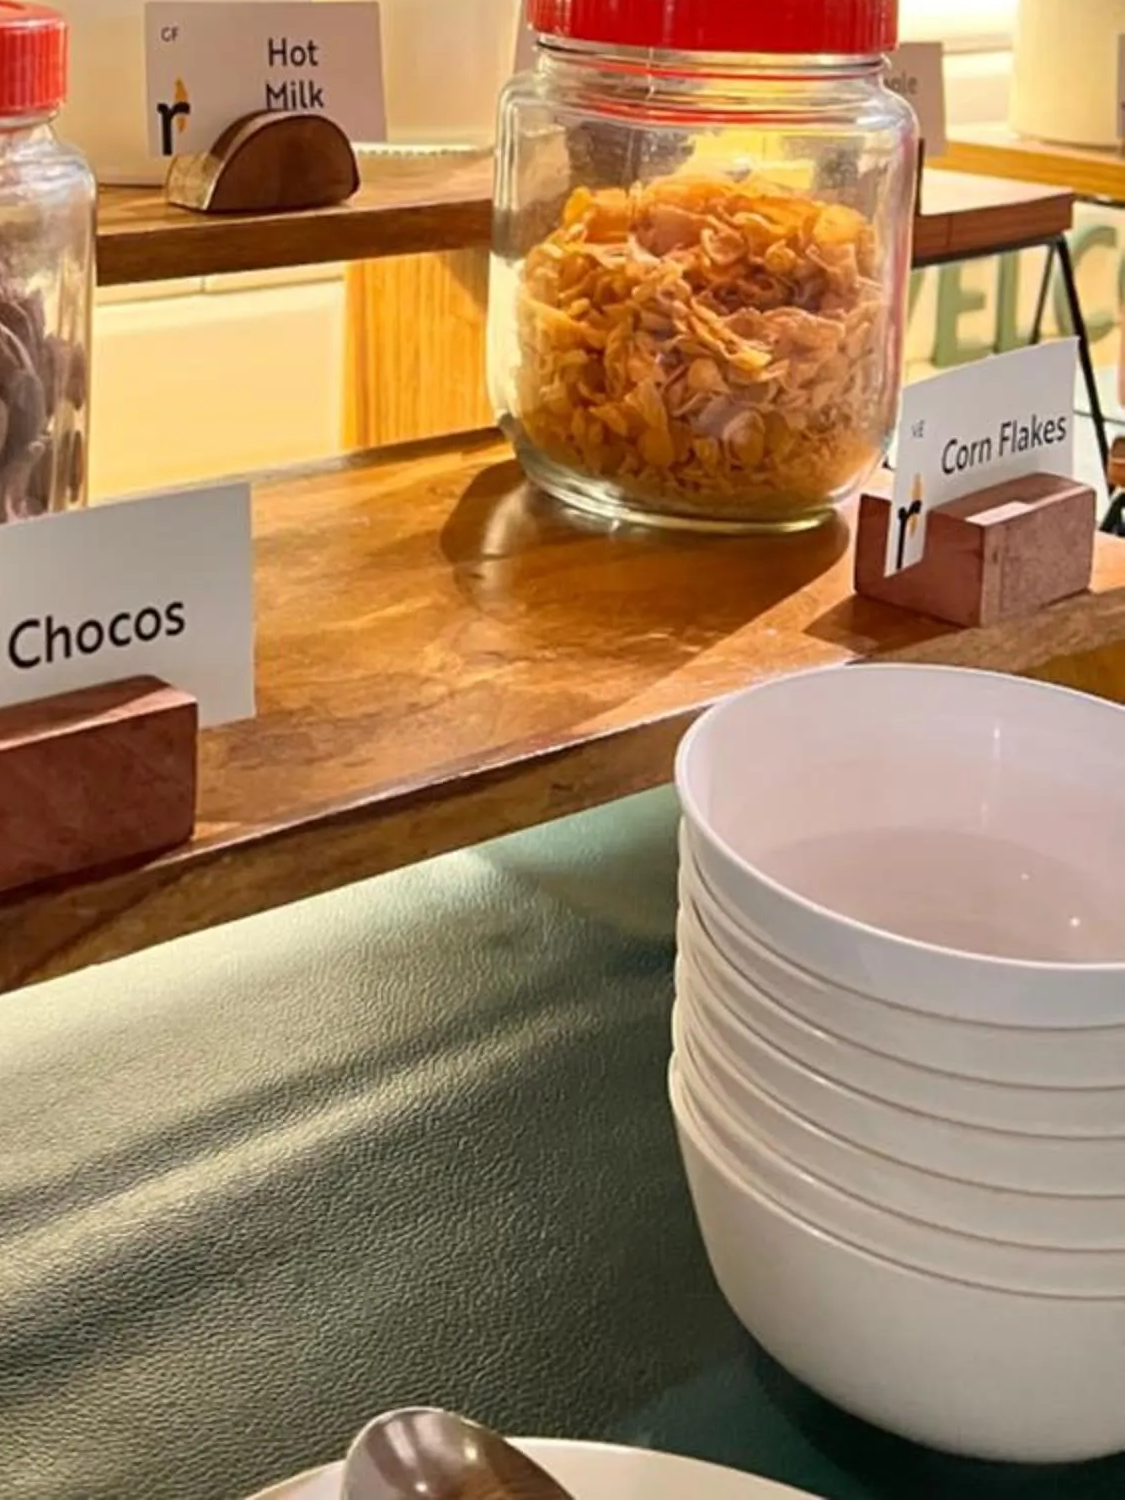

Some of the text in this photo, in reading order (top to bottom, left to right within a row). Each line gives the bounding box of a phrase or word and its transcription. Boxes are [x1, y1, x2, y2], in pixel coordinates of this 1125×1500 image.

[268, 38, 319, 67] Hot
[266, 81, 324, 111] Milk
[912, 419, 925, 437] VE
[941, 414, 1067, 475] Corn Flakes
[8, 601, 186, 668] Chocos
